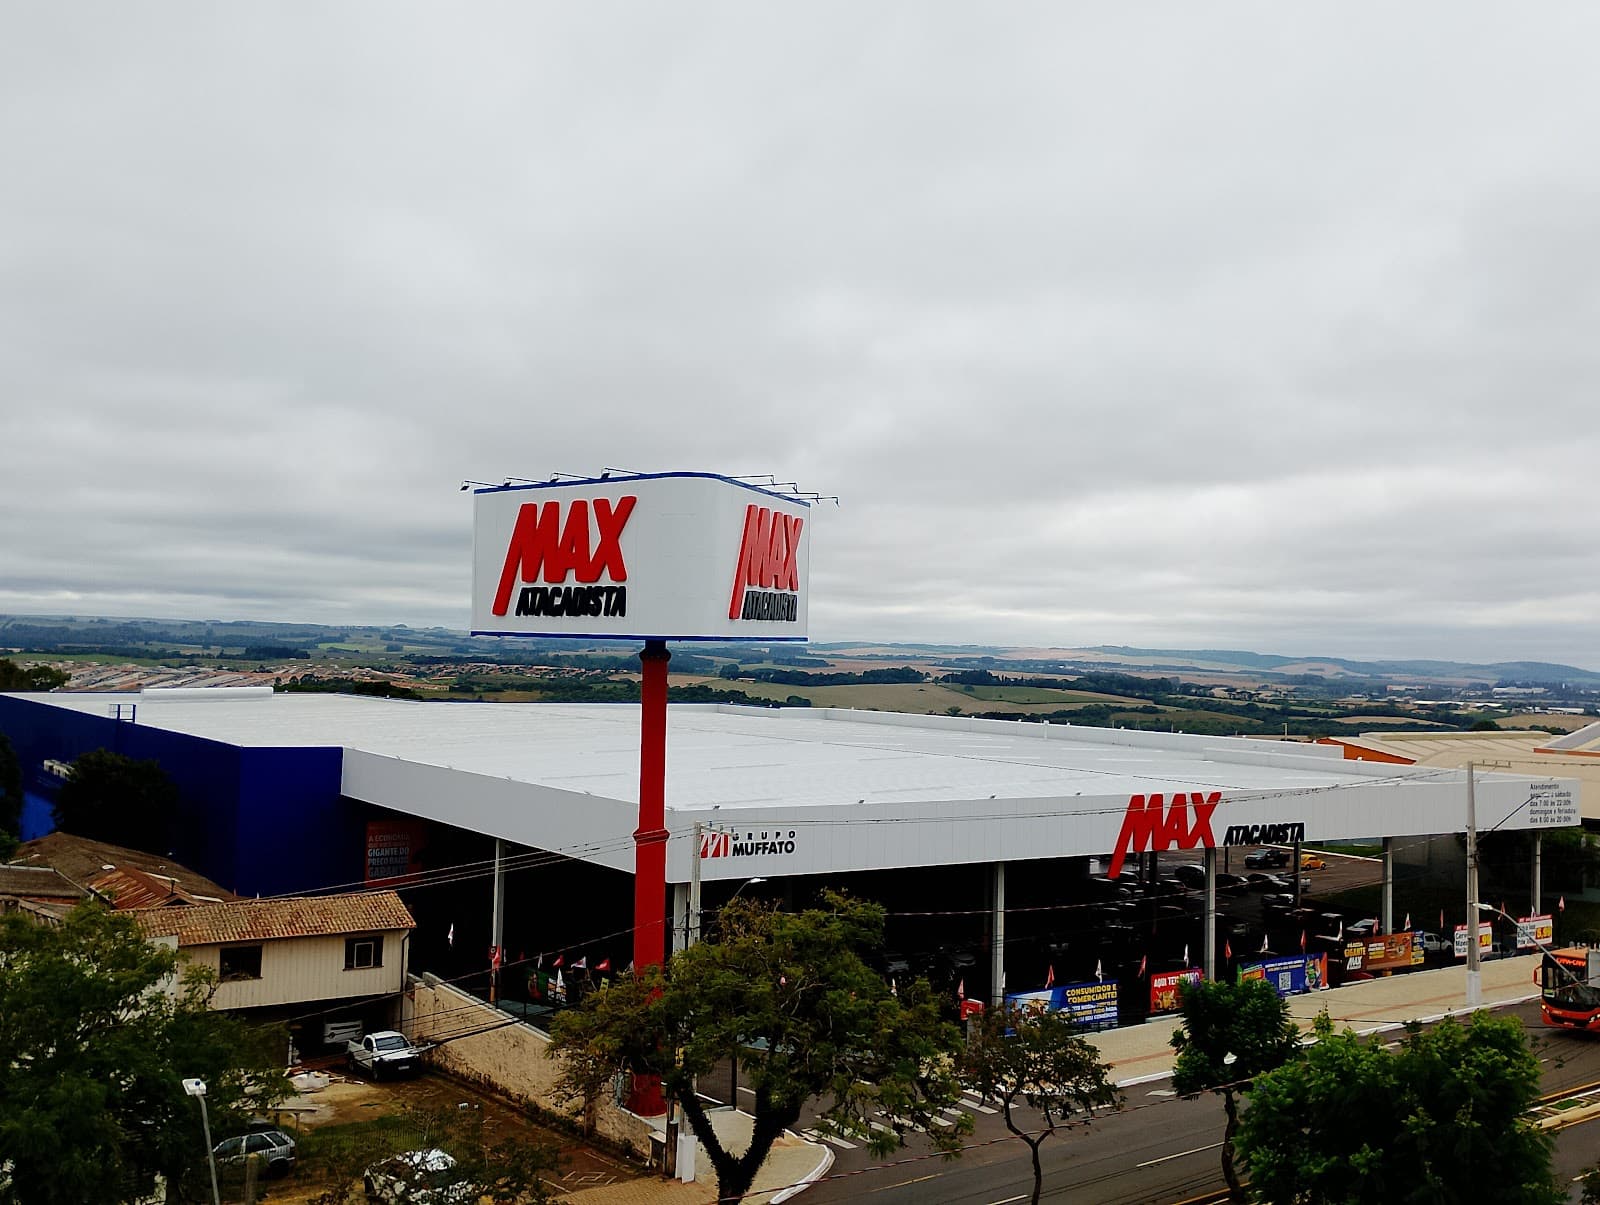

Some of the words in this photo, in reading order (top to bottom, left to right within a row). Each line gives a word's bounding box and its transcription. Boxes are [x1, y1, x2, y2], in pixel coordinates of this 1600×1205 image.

[492, 495, 637, 617] MAX
[729, 504, 804, 621] MAX
[515, 585, 627, 618] ATACADISTA
[742, 591, 798, 622] ATACADISTA
[732, 831, 796, 841] GRUPO
[1107, 791, 1222, 880] MAX
[1223, 822, 1306, 847] ATACADISTA
[368, 847, 399, 857] GIGANTE
[732, 841, 795, 857] MUFFATO
[1066, 985, 1111, 997] CONSUMIDOR
[1112, 983, 1117, 991] E
